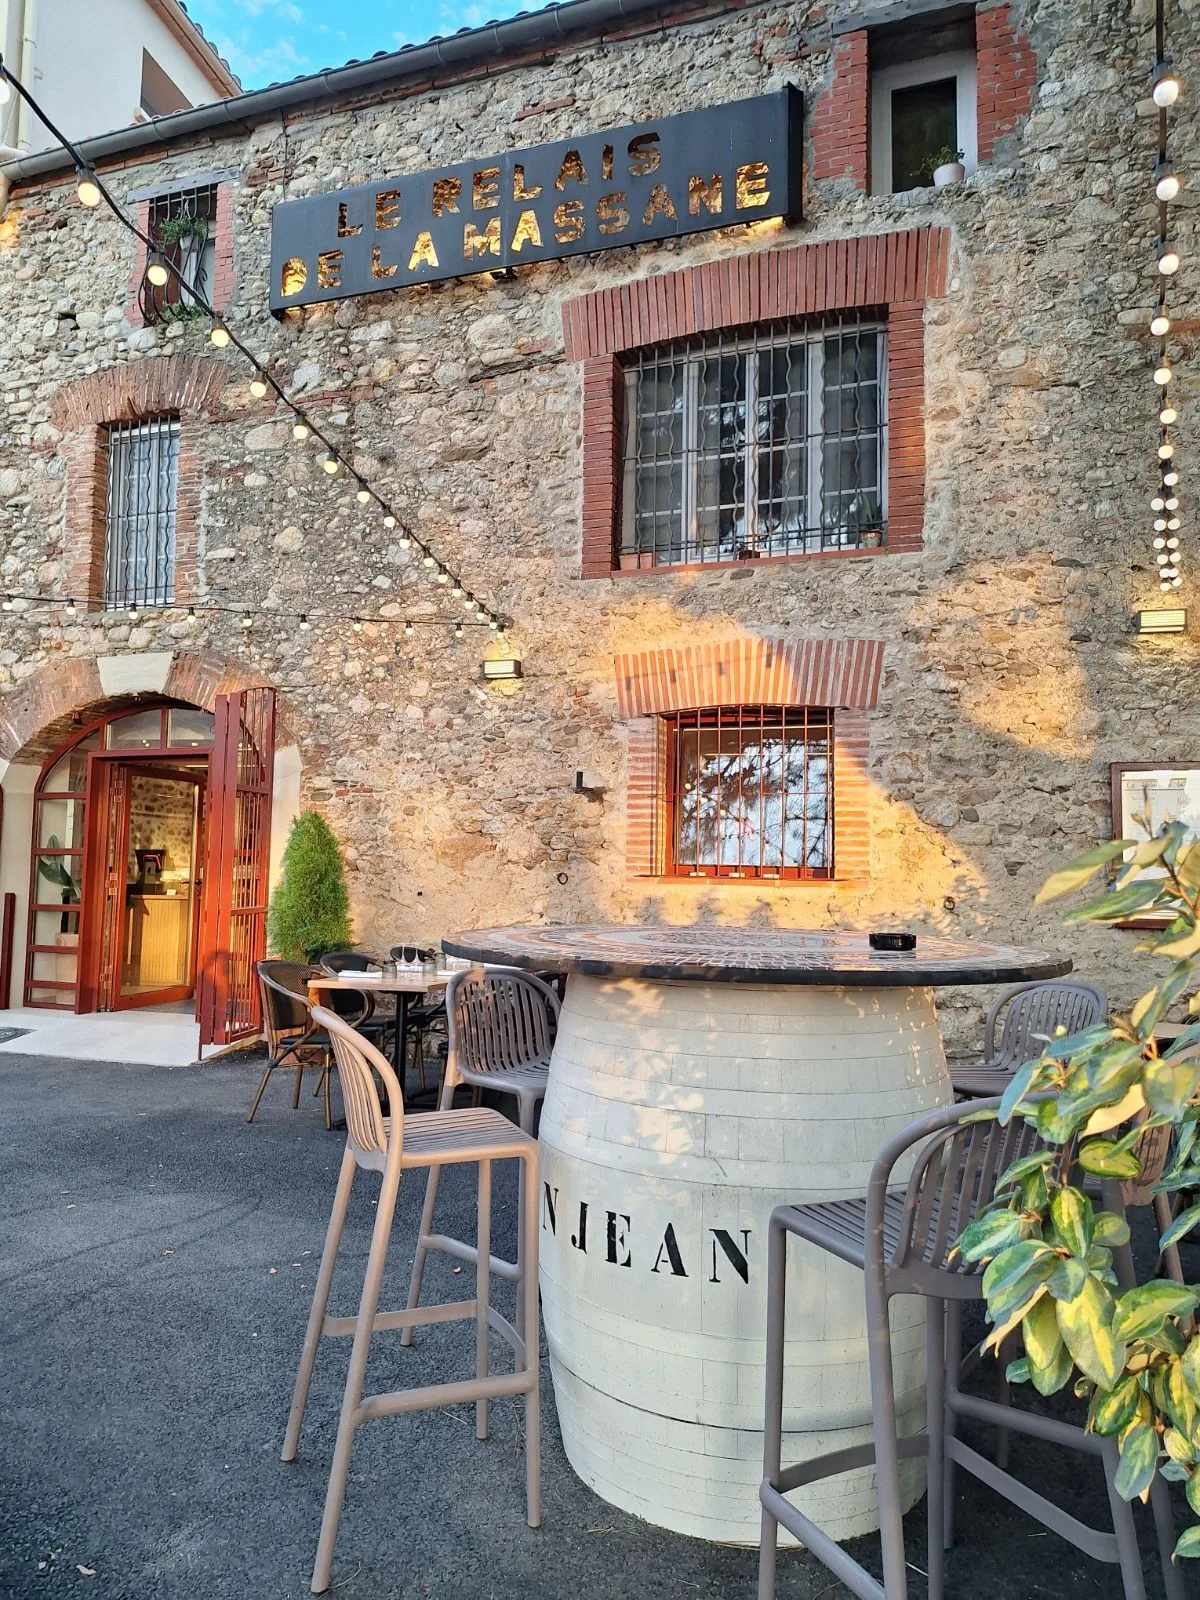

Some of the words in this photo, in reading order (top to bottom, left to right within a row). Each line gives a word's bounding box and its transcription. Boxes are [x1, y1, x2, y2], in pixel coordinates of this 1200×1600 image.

[281, 249, 343, 297] DE
[372, 231, 440, 279] LA
[463, 161, 771, 261] MASSANE
[336, 190, 402, 238] LE
[432, 132, 661, 217] RELAIS
